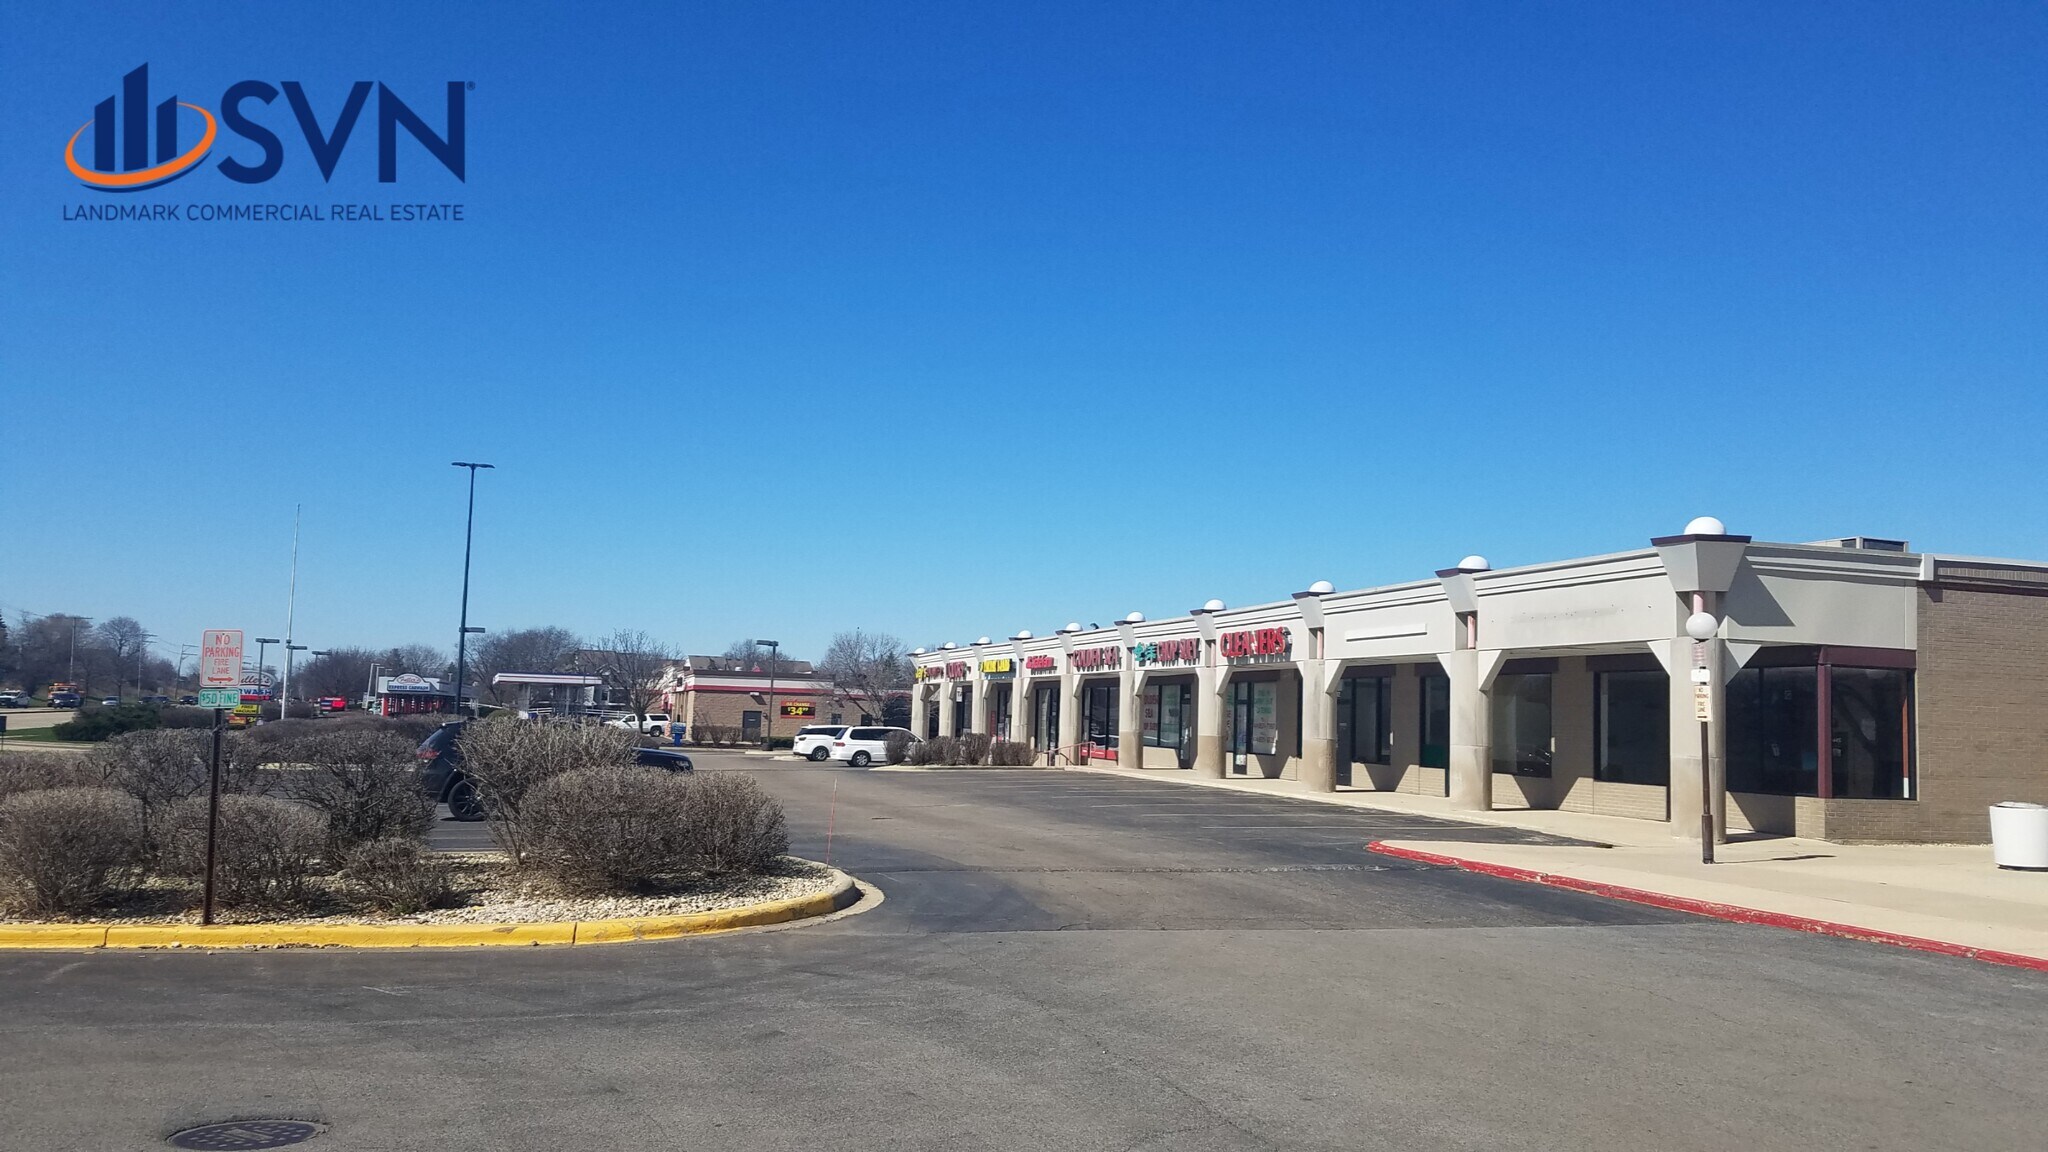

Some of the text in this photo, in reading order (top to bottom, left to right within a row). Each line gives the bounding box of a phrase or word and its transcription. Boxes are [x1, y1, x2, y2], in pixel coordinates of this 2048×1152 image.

[215, 634, 231, 645] NO
[205, 646, 240, 658] PARKING
[213, 658, 229, 666] FIRE
[211, 667, 230, 675] LANE
[201, 692, 239, 704] $50 FINE
